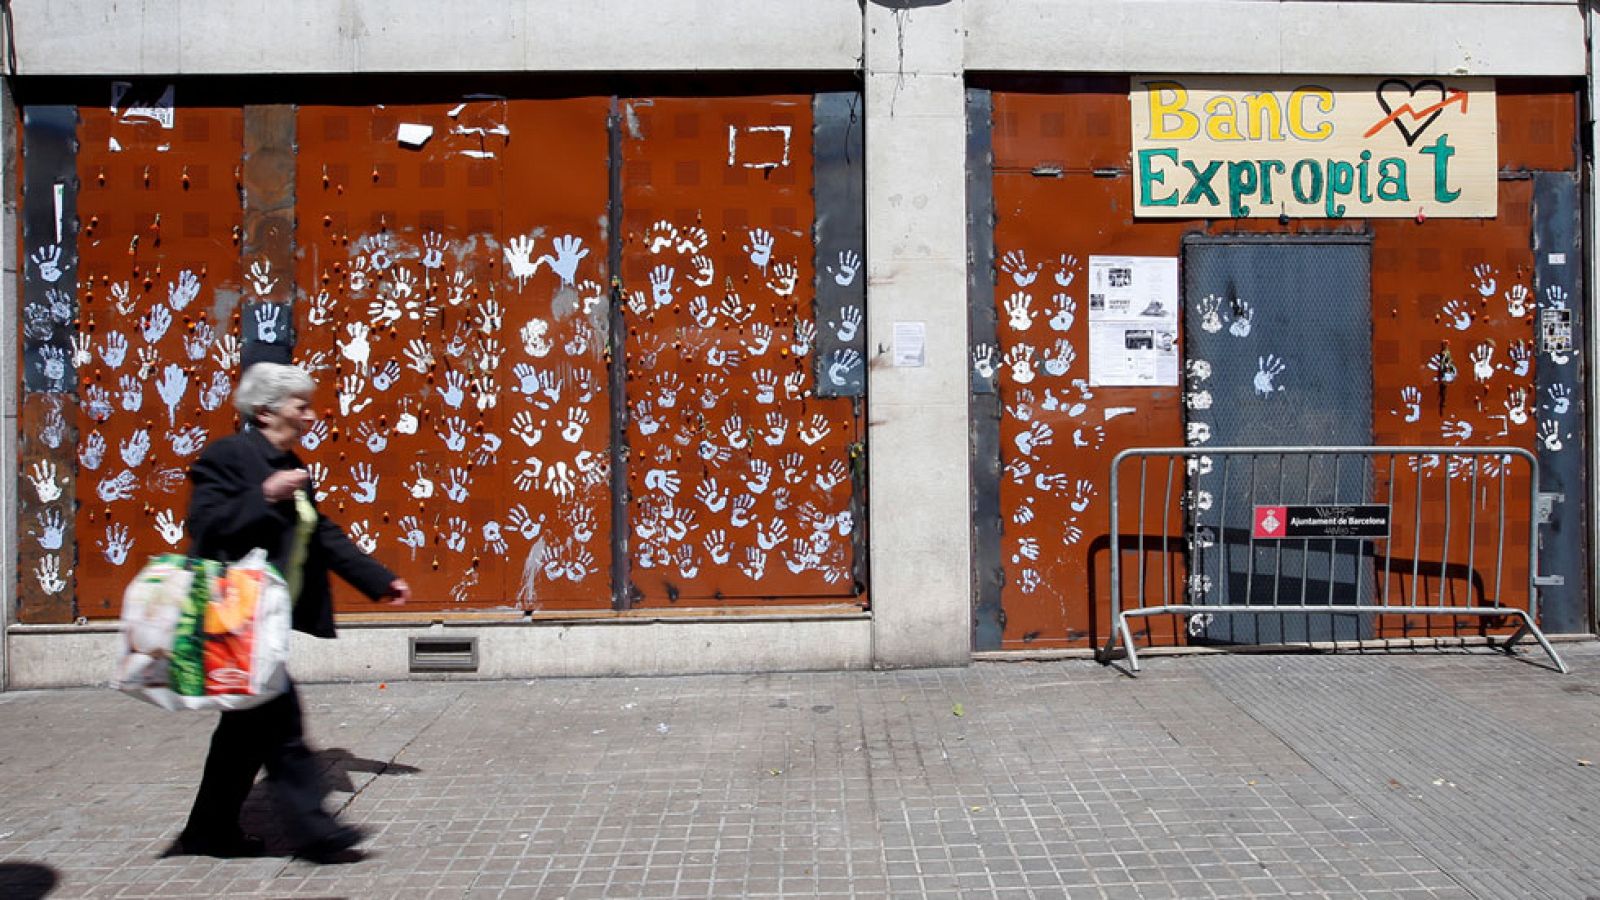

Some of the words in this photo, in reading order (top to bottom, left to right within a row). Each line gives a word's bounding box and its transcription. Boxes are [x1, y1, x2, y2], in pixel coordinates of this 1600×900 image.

[1137, 133, 1462, 218] Expropiat
[1290, 517, 1336, 527] Ajuntament
[1338, 517, 1348, 525] de
[1348, 516, 1386, 525] Barcelona
